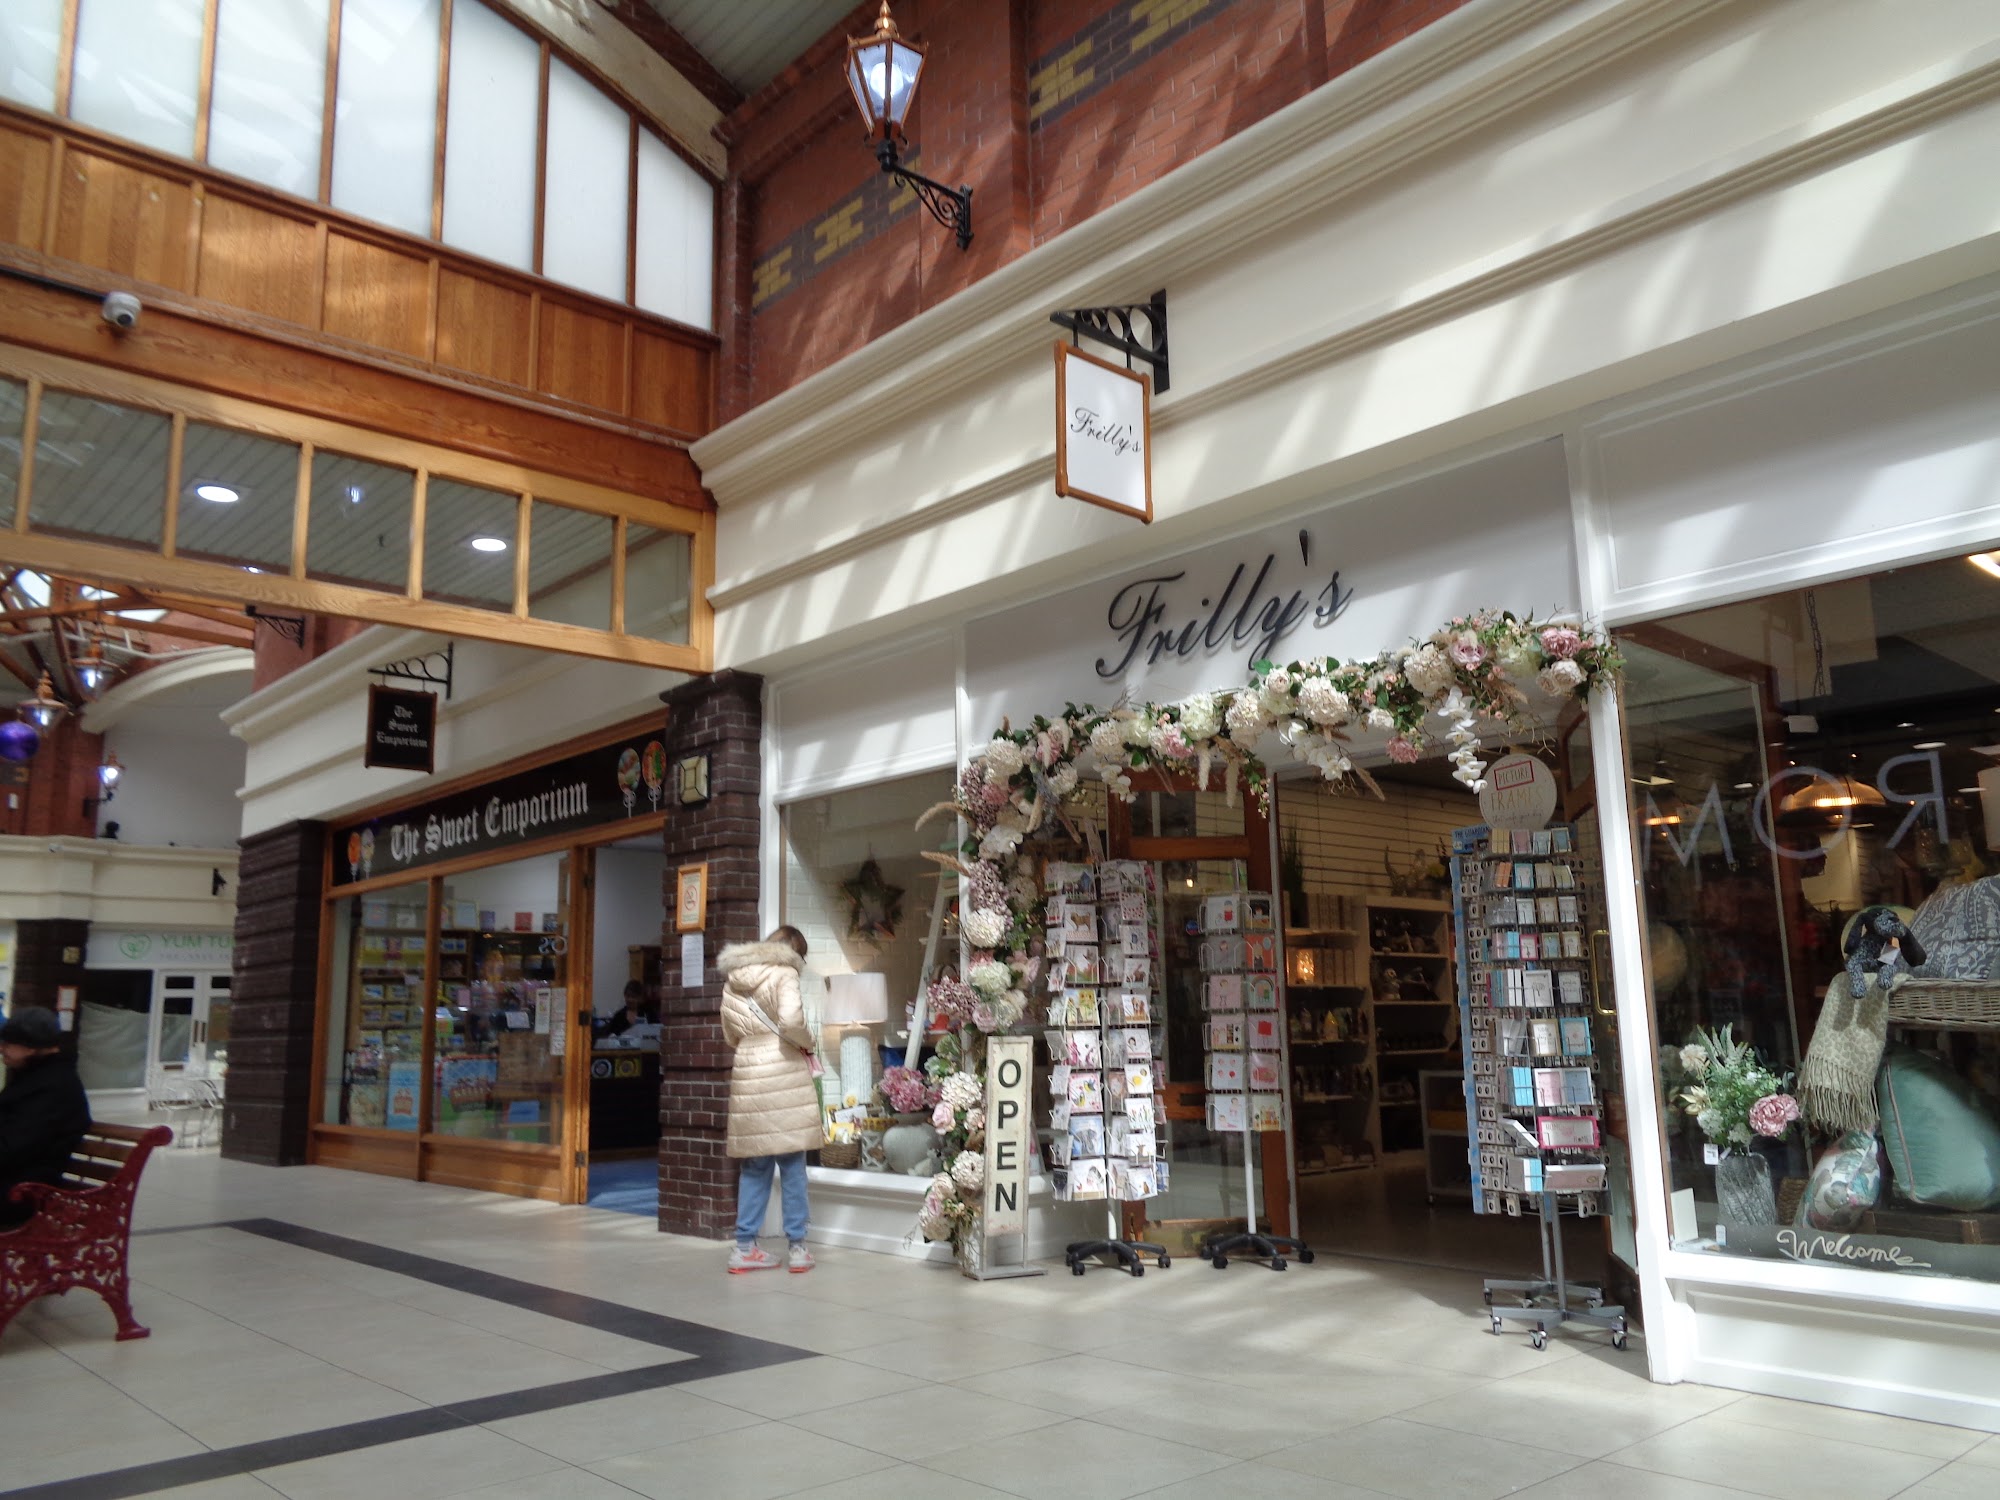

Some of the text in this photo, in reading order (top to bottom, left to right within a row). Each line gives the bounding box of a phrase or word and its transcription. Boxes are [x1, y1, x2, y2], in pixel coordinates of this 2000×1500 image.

[1070, 407, 1142, 456] Frilly's
[1095, 529, 1353, 678] Frilly's
[394, 705, 414, 718] The
[388, 718, 418, 733] Sweet
[376, 730, 428, 748] Emporium
[1497, 767, 1530, 786] PICTURE
[1490, 785, 1544, 811] FRAMES
[390, 780, 589, 864] The Sweet Emporium
[161, 934, 202, 949] YUM
[995, 1059, 1022, 1212] OPEN
[1777, 1229, 1932, 1268] Welcome
